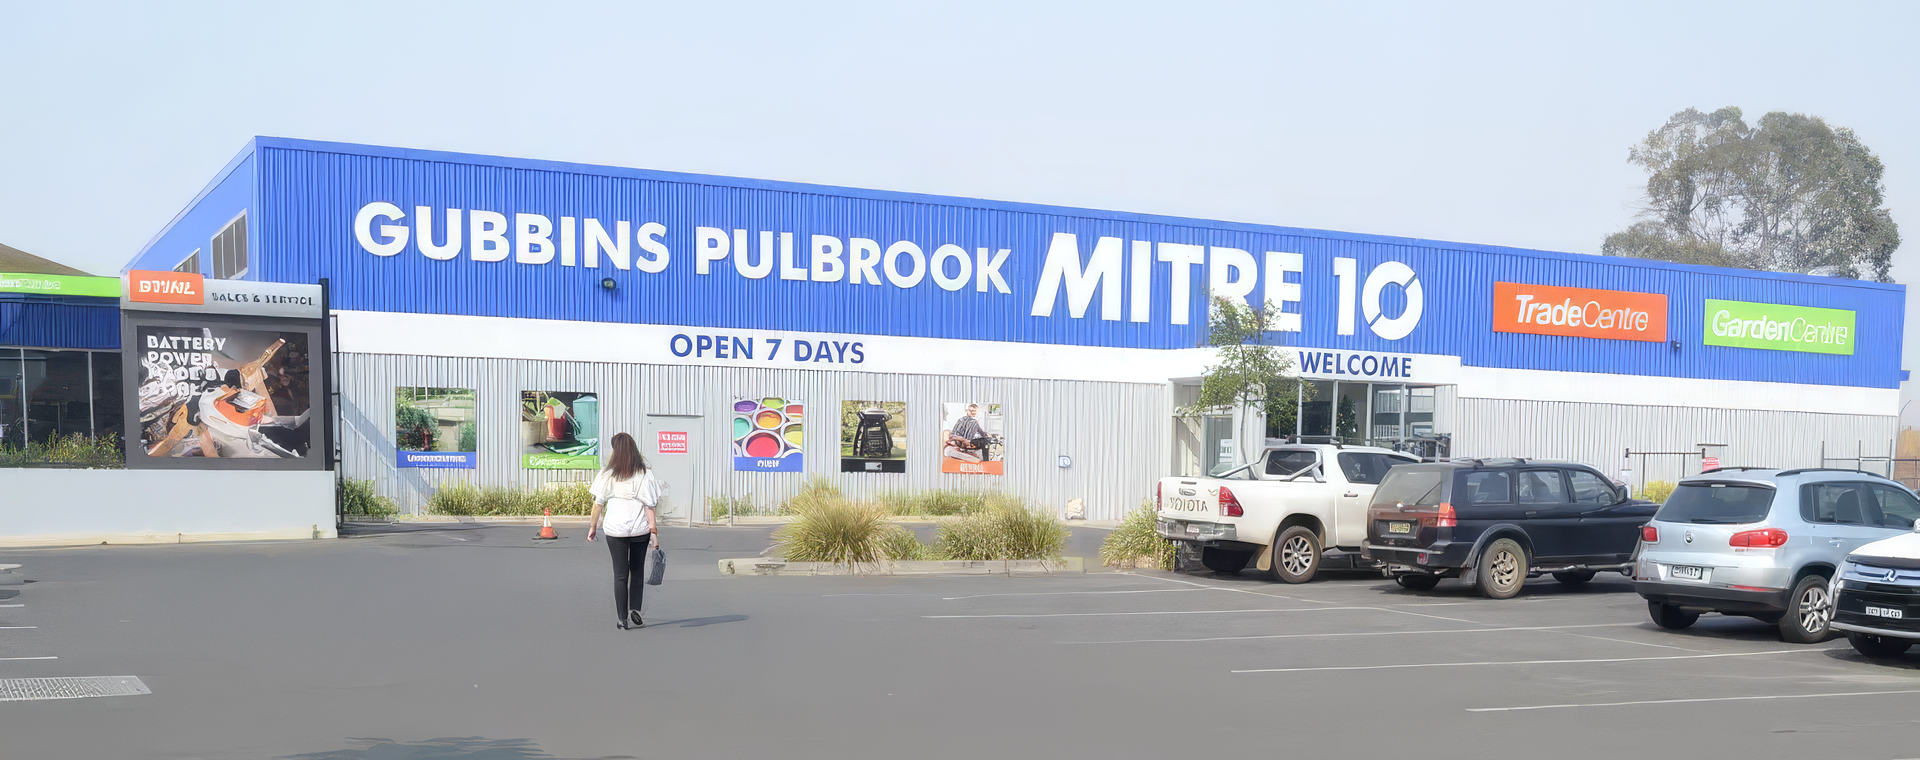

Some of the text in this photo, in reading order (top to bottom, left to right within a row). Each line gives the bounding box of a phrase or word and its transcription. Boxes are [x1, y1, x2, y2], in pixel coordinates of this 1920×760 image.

[354, 201, 1012, 294] GUBBINS PULBROOK
[1031, 232, 1423, 341] MITRE 10
[147, 335, 226, 351] BATTERY
[670, 333, 865, 364] OPEN 7 DAYS
[1299, 351, 1412, 378] WELCOME
